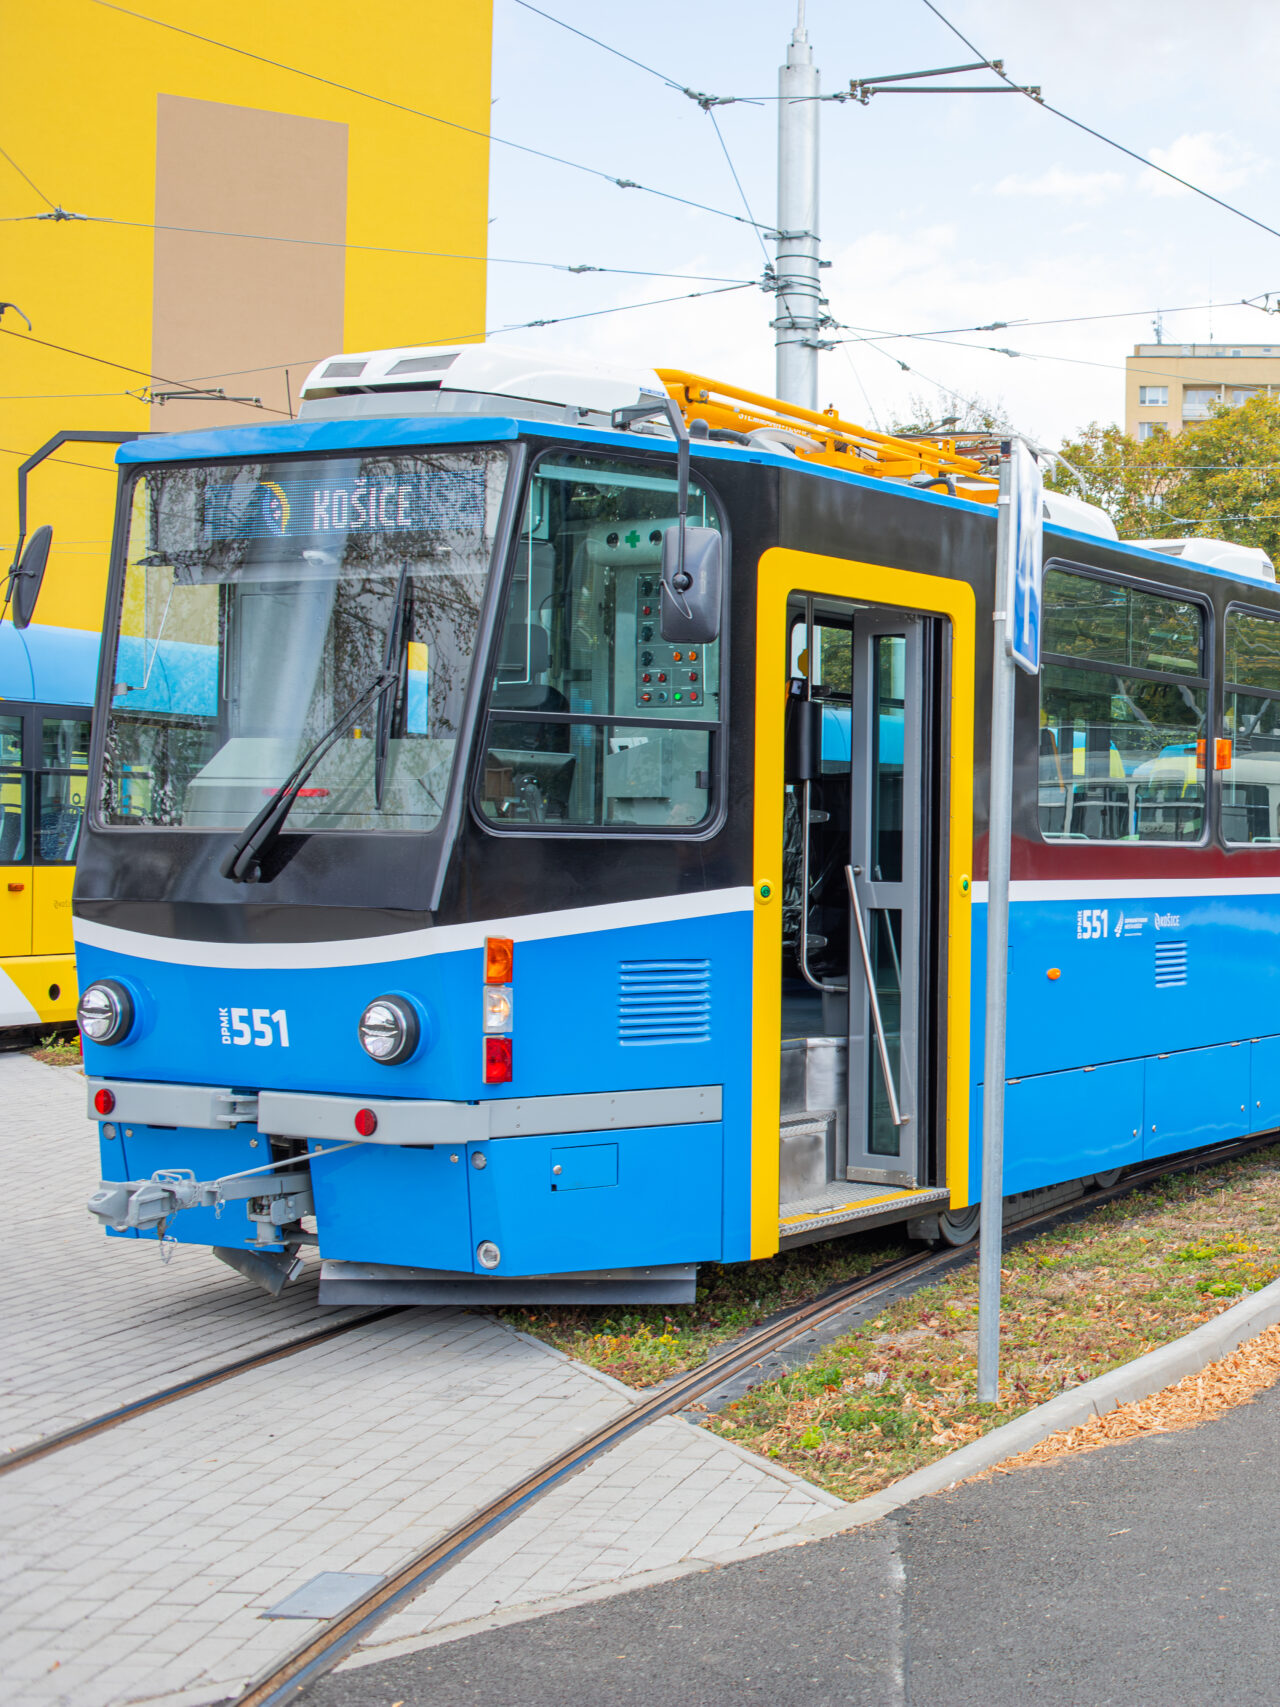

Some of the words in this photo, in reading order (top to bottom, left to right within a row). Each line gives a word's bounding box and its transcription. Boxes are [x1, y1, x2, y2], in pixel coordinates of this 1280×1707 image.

[313, 479, 413, 530] KOŠICE
[1082, 909, 1108, 939] 551
[218, 1007, 232, 1045] DPMK
[230, 1007, 290, 1048] 551
